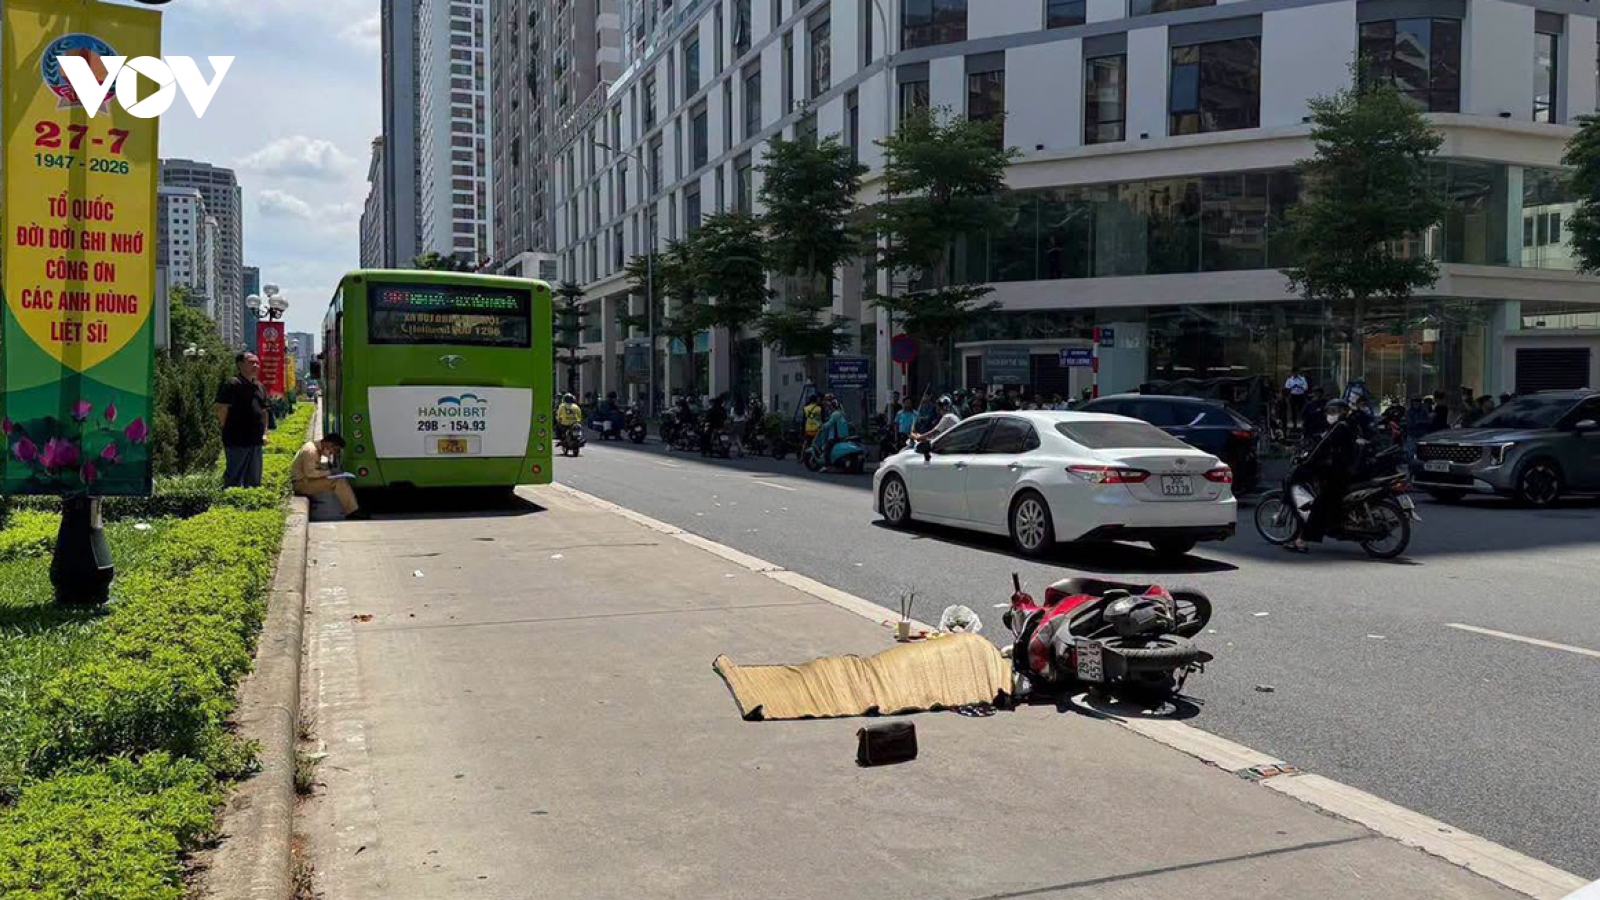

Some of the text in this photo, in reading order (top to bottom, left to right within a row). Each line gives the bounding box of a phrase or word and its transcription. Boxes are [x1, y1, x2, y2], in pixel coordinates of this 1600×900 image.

[34, 120, 130, 154] 27-7
[34, 153, 74, 169] 1947
[89, 159, 130, 175] 2026
[48, 190, 114, 222] TỔ QUỐC
[17, 222, 144, 254] ĐỜI ĐỜI GHI NHỚ
[46, 255, 115, 283] CÔNG ƠN
[21, 285, 138, 314] CÁC ANH HÙNG
[51, 318, 82, 346] LIỆT
[418, 406, 487, 417] HANOI BRT
[417, 420, 439, 432] 29B
[450, 420, 486, 432] 154.93
